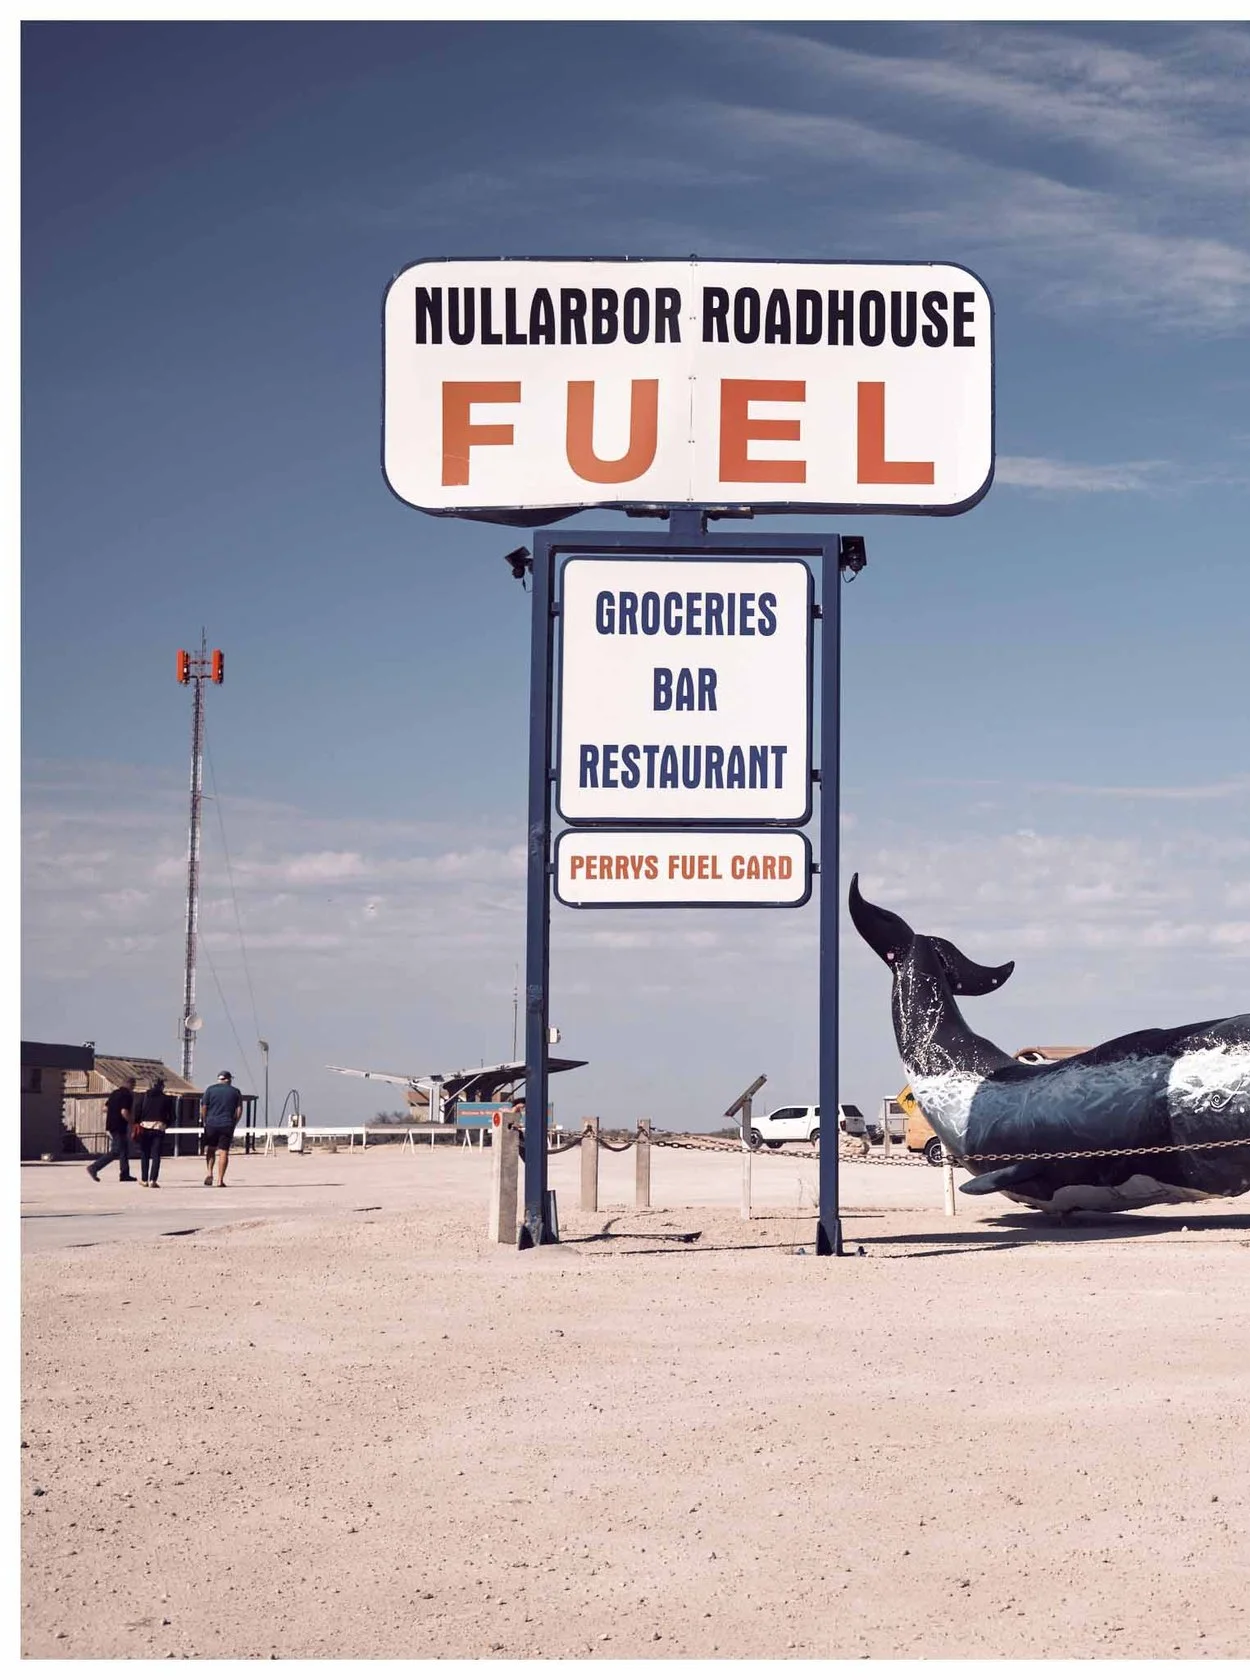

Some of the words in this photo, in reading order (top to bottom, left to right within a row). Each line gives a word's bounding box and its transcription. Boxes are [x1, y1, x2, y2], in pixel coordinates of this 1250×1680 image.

[415, 286, 682, 346] NULLARBOR
[702, 286, 976, 348] ROADHOUSE
[441, 377, 935, 487] FUEL
[595, 590, 777, 637] GROCERIES
[653, 667, 718, 712] BAR
[579, 743, 788, 790] RESTAURANT
[570, 854, 659, 880] PERRYS
[668, 854, 723, 880] FUEL
[731, 854, 793, 880] CARD
